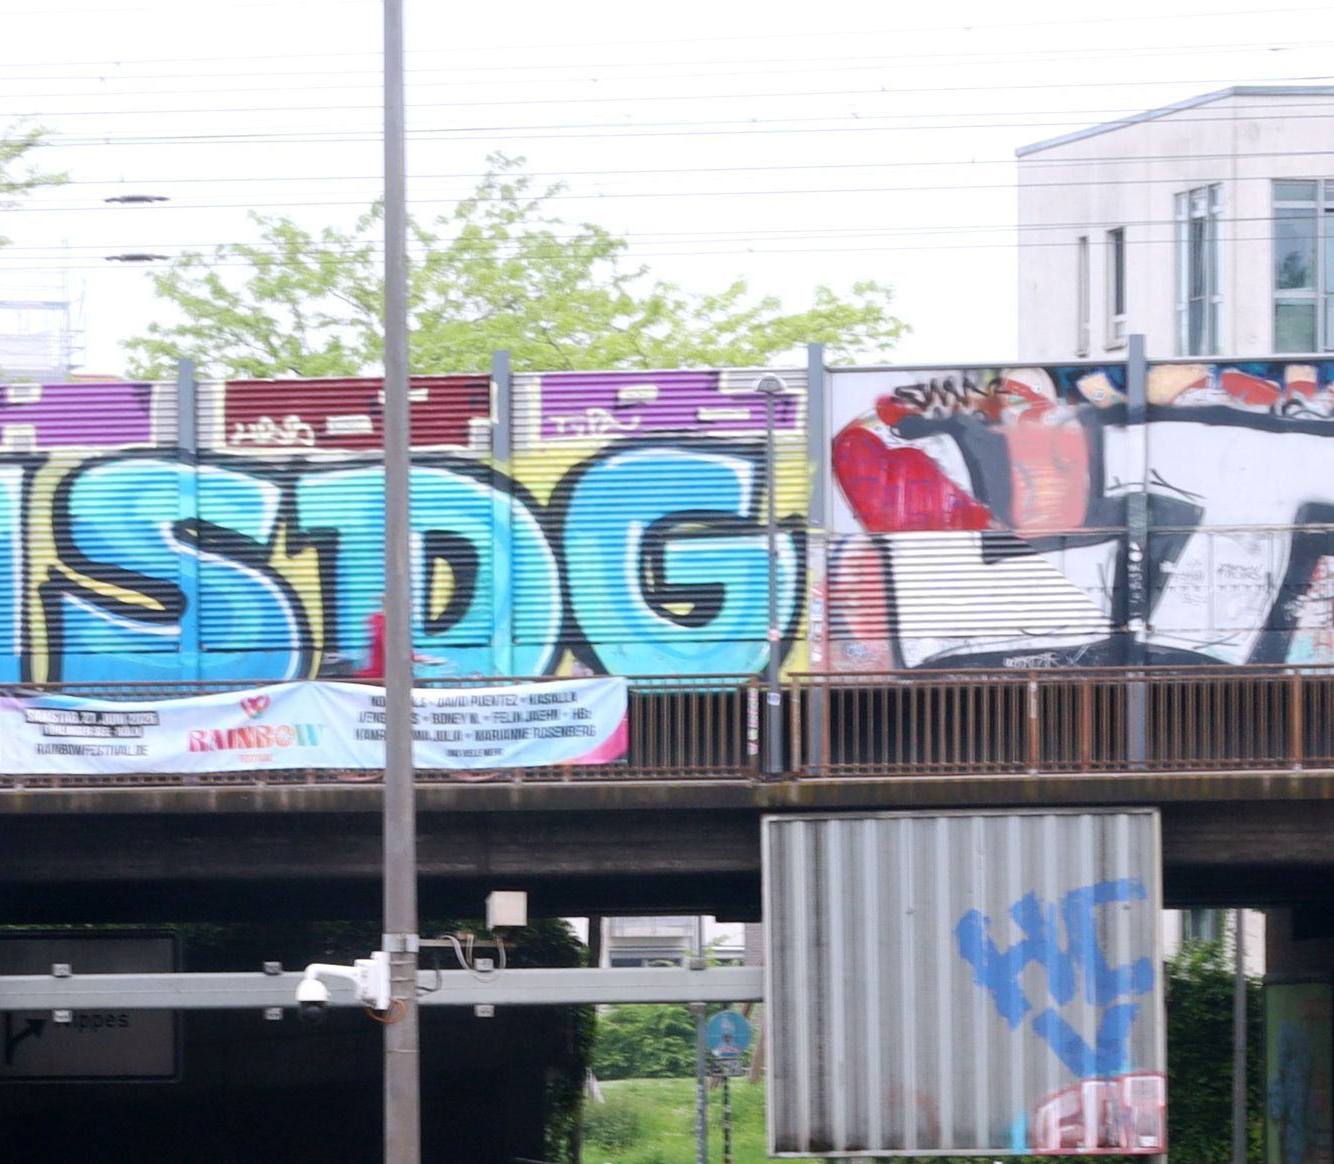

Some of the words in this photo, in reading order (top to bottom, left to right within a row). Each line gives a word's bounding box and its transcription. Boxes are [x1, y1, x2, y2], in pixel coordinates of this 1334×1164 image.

[188, 723, 324, 753] RAINBOW
[475, 727, 532, 742] MARIANNE
[533, 724, 597, 740] ROSENBERG
